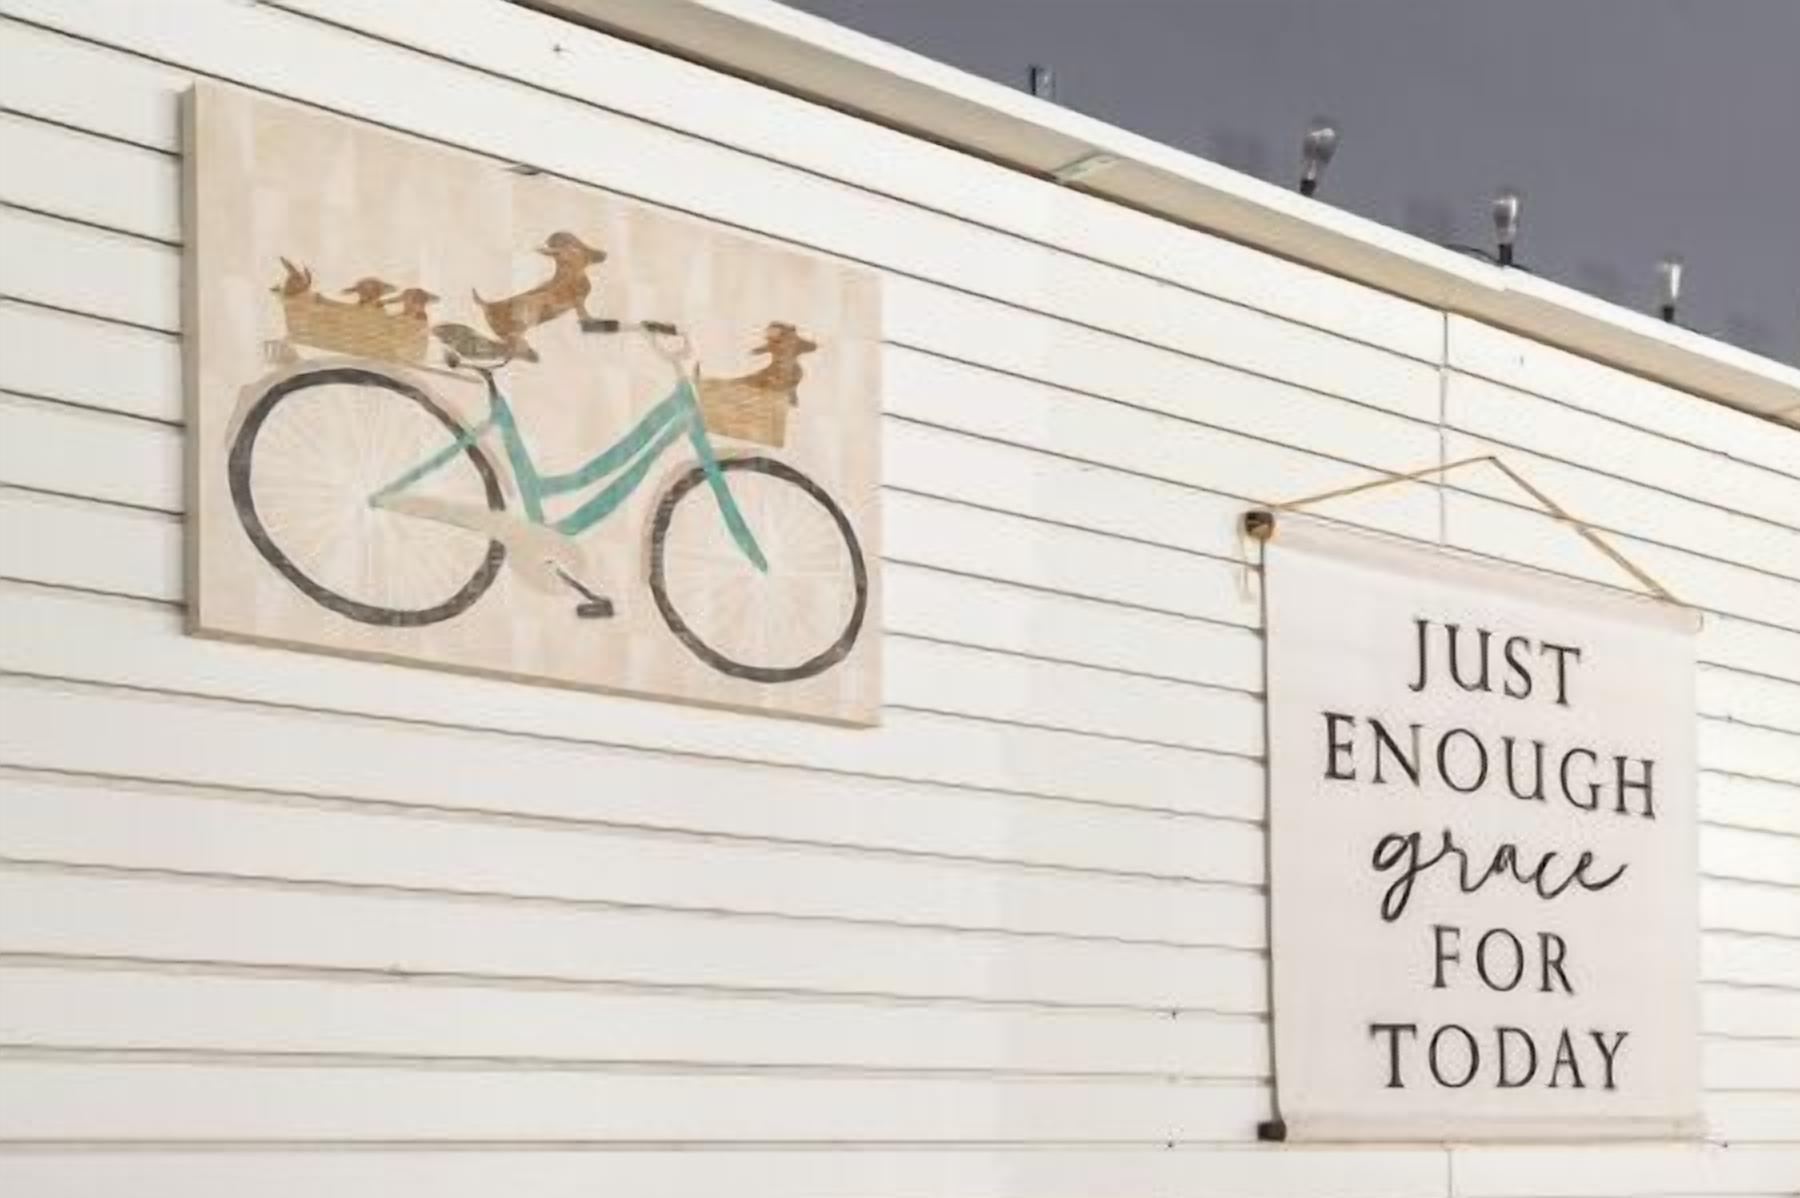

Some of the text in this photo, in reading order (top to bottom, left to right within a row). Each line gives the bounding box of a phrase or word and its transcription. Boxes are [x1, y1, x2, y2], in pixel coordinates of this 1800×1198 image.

[1407, 618, 1582, 708] JUST
[1320, 710, 1656, 821] ENOUGH
[1371, 828, 1629, 924] grace
[1432, 924, 1574, 996] FOR
[1368, 1022, 1629, 1091] TODAY
